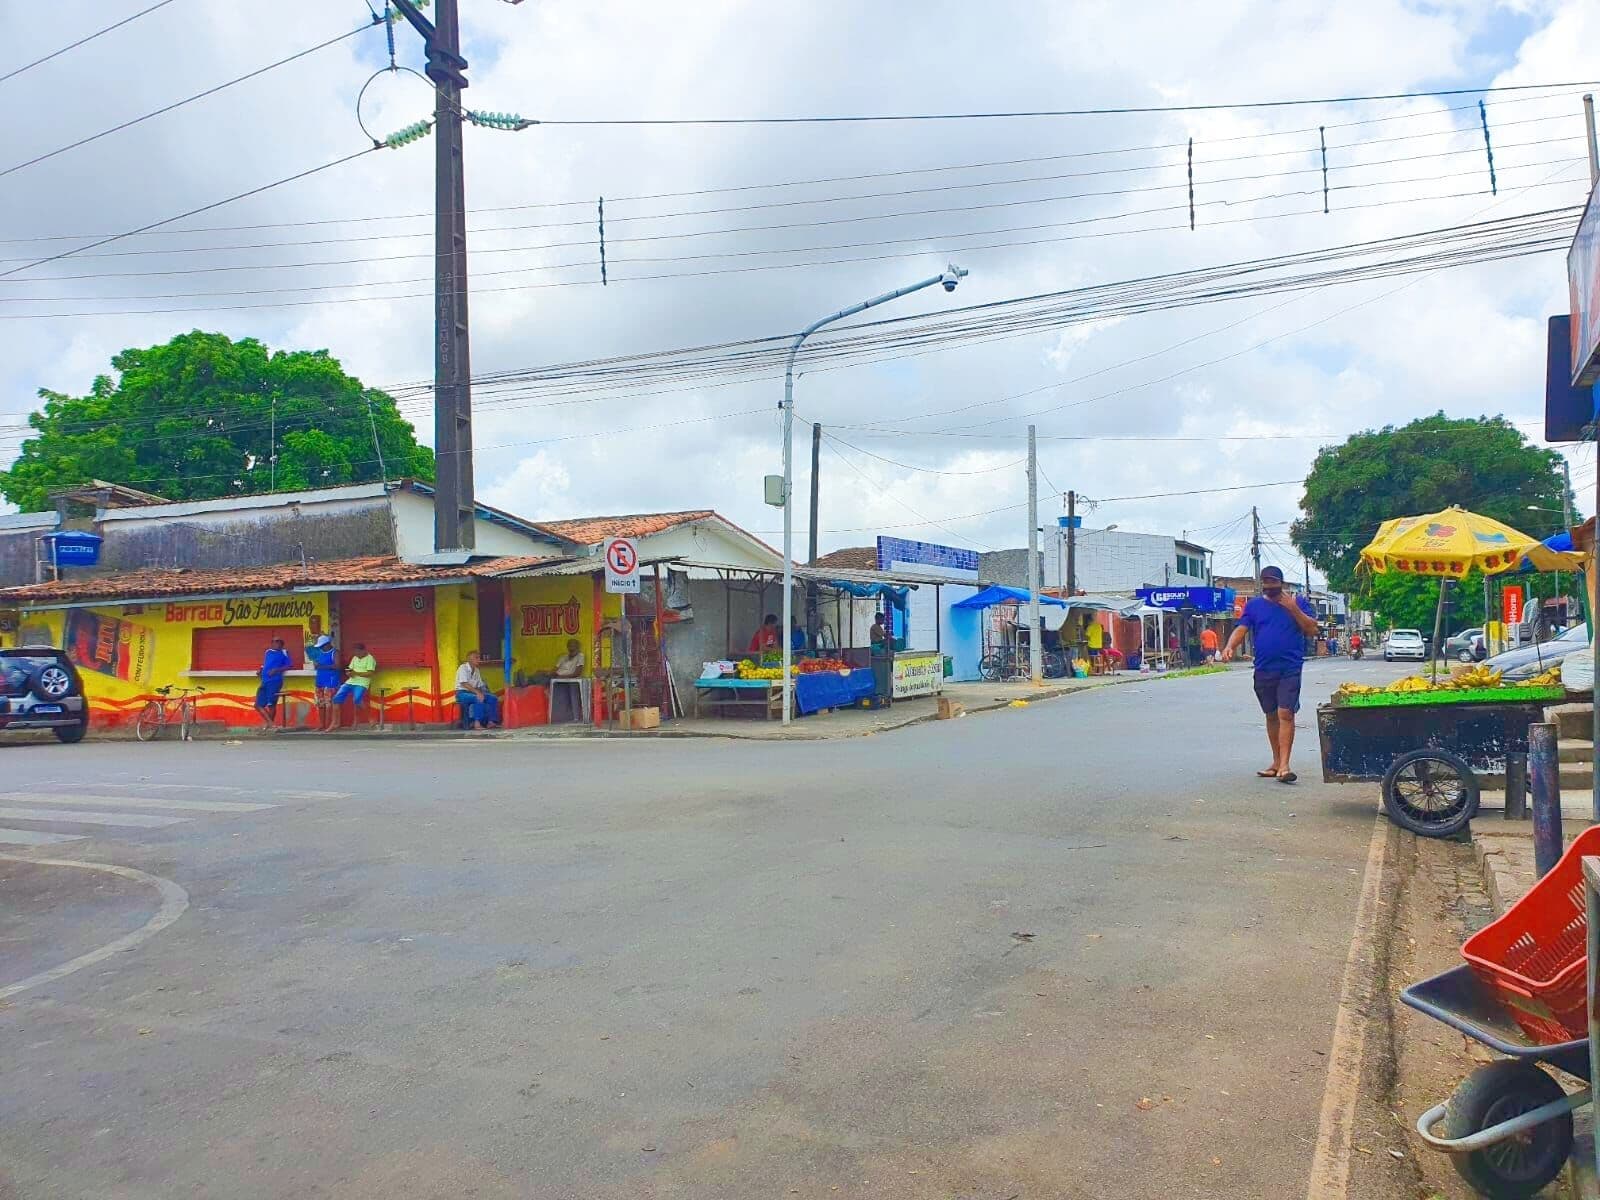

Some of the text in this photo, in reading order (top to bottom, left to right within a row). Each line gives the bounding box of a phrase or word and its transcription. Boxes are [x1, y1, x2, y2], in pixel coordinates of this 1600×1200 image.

[165, 602, 222, 622] Barraca
[223, 599, 251, 625] São
[252, 597, 314, 619] Francisco
[521, 595, 580, 635] PITÚ
